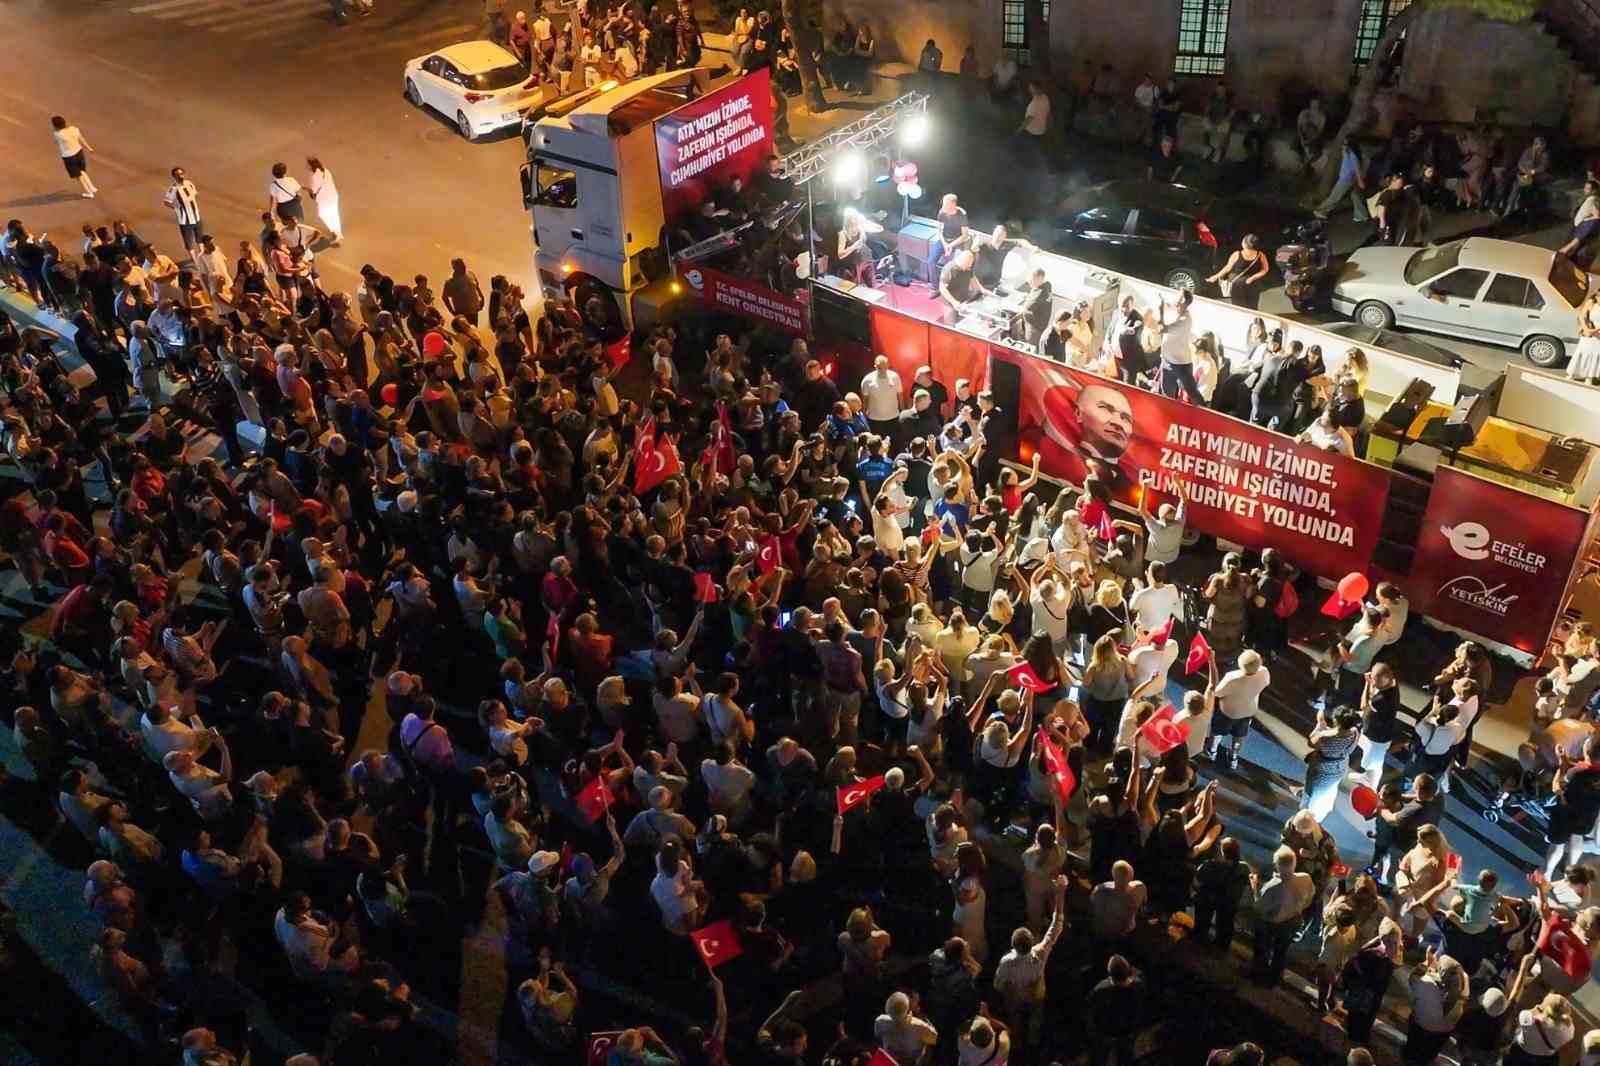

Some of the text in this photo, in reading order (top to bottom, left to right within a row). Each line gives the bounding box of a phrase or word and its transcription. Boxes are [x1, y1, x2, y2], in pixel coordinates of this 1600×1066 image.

[677, 109, 721, 143] ATA'MIZIN
[670, 125, 765, 186] CUMHURİYET YOLUNDA
[677, 131, 716, 162] ZAFERİN
[715, 292, 741, 310] KENT
[1166, 423, 1338, 489] ATA'MIZIN İZİNDE,
[1159, 448, 1337, 517] ZAFERİN IŞIĞINDA,
[1262, 502, 1354, 547] YOLUNDA
[1491, 540, 1546, 568] EFELER
